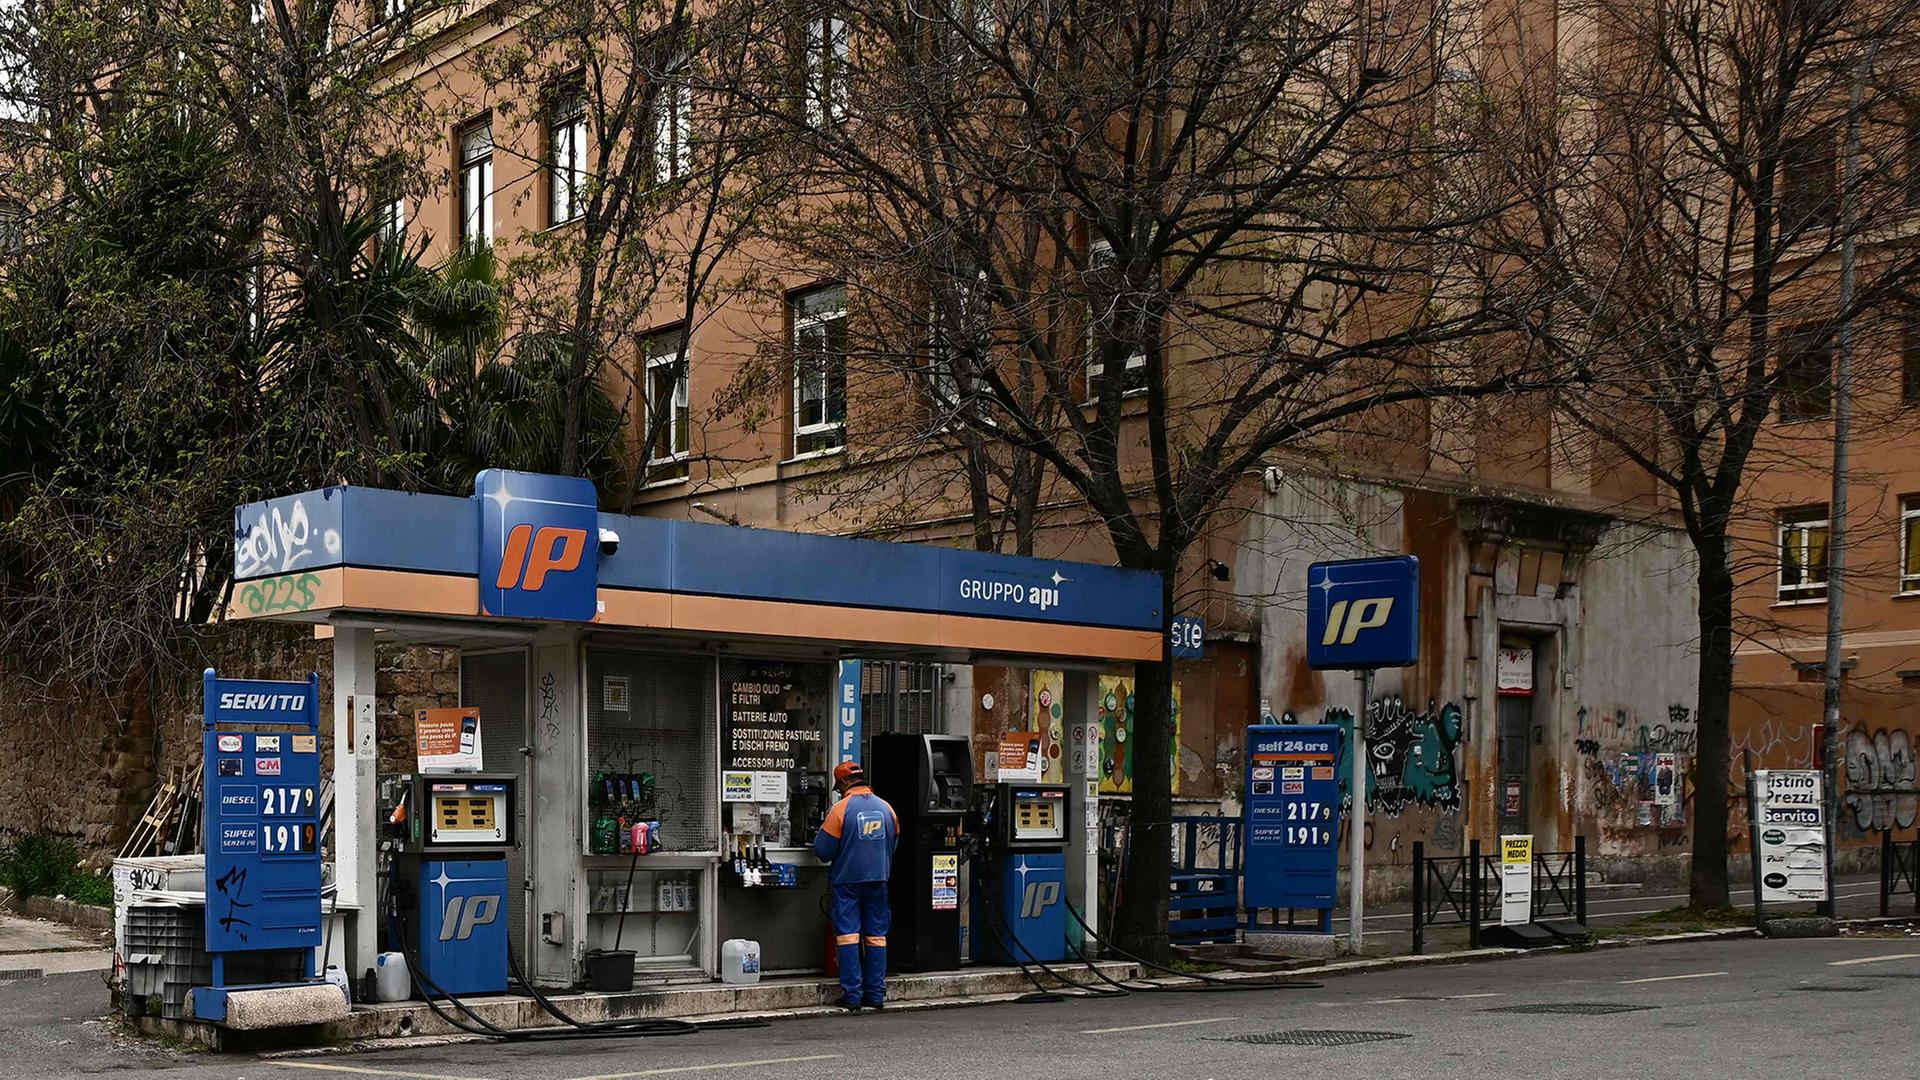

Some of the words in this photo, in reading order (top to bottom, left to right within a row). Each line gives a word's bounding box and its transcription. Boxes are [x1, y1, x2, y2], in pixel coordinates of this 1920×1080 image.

[496, 524, 588, 591] IP
[960, 579, 1024, 603] GRUPPO
[1029, 583, 1059, 610] api
[1321, 597, 1394, 646] IP
[732, 682, 760, 693] CAMBIO
[763, 684, 780, 694] OLIO
[219, 693, 305, 711] SERVITO
[732, 694, 737, 704] E
[739, 694, 760, 705] FILTRI
[732, 711, 767, 722] BATTERIE
[768, 712, 788, 723] AUTO
[732, 729, 784, 740] SOSTITUZIONE
[786, 730, 820, 740] PASTIGLIE
[732, 740, 737, 750] E
[739, 740, 764, 751] DISCHI
[765, 741, 789, 751] FRENO
[257, 760, 279, 770] CM
[732, 757, 774, 768] ACCESSORI
[775, 759, 795, 769] AUTO
[222, 796, 256, 805] DIESEL
[863, 820, 881, 834] IP
[223, 829, 255, 838] SUPER
[432, 829, 438, 839] 4
[495, 828, 501, 839] 3
[1505, 840, 1528, 848] PREZZO
[1507, 850, 1527, 858] MEDIO
[1020, 882, 1060, 918] IP
[439, 895, 500, 940] IP
